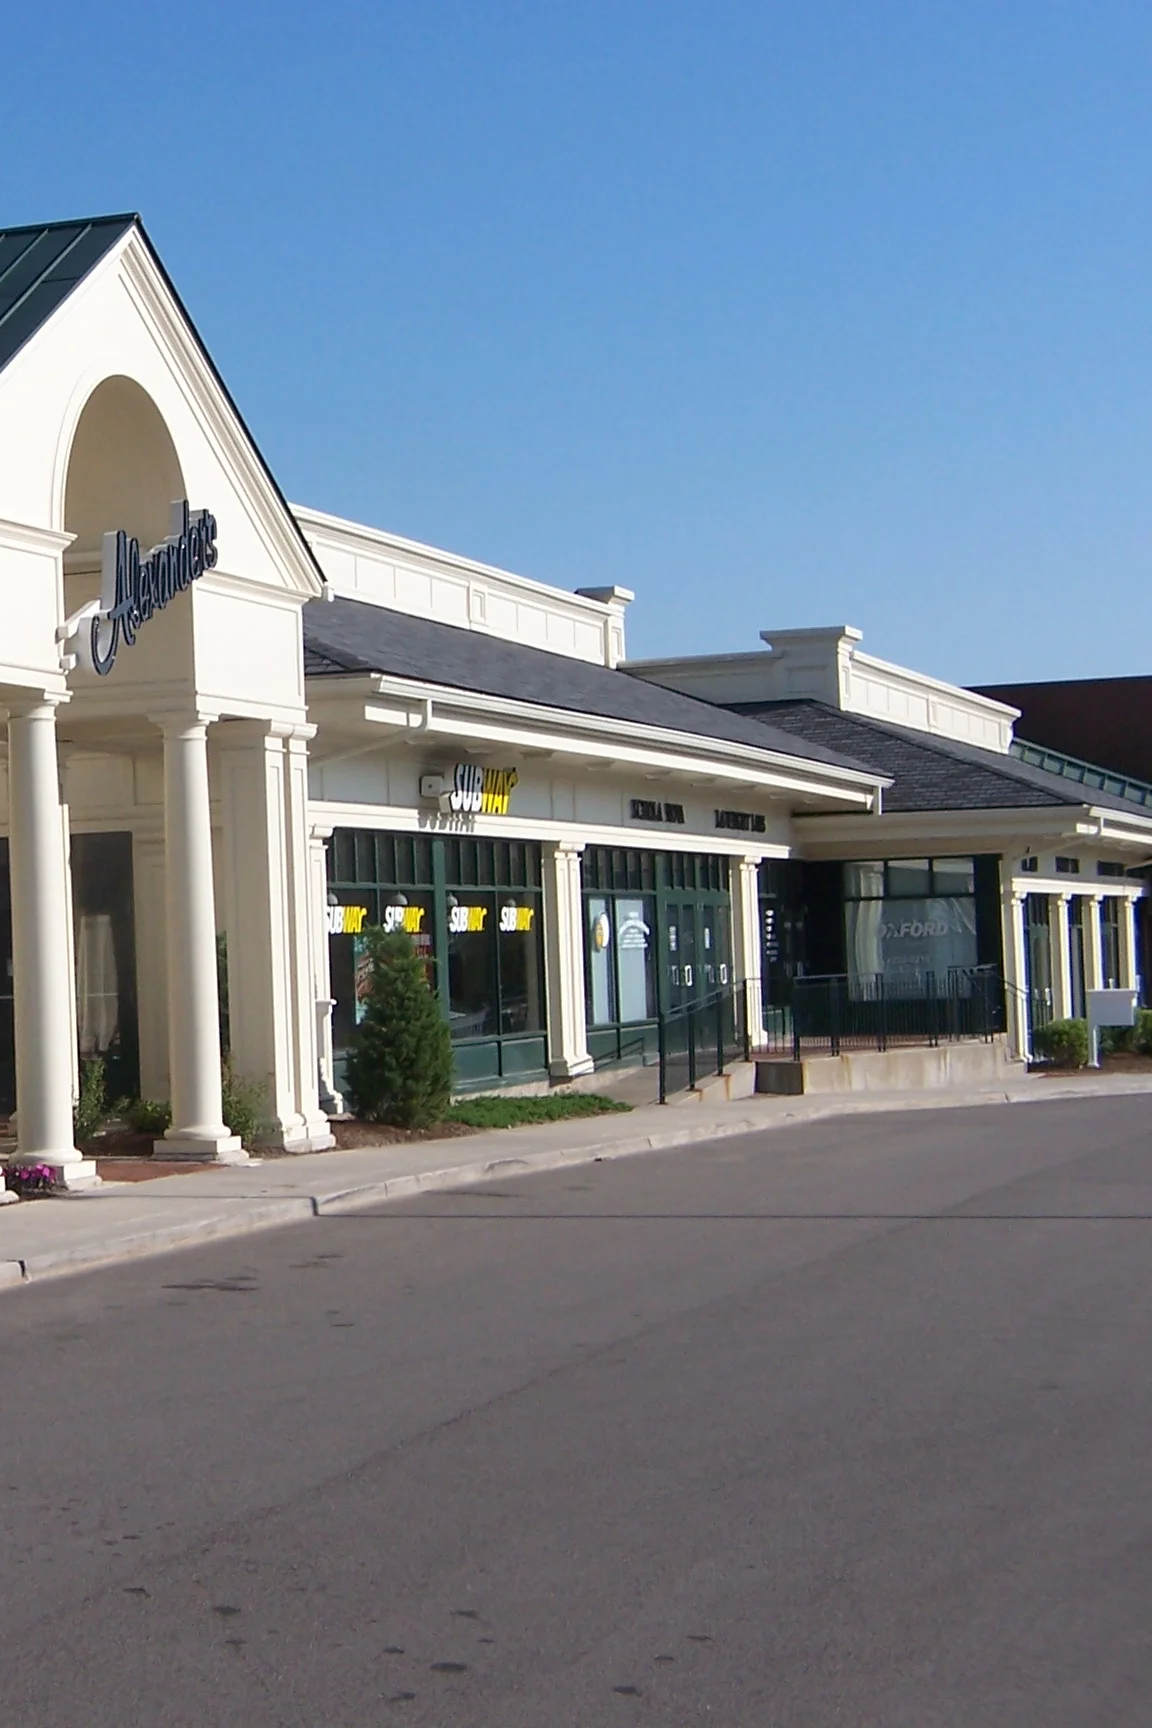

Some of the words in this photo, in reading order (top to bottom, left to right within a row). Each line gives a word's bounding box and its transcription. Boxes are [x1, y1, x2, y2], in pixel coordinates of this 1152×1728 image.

[449, 763, 519, 815] SUBWAY
[449, 905, 488, 933] SUBWAY
[499, 906, 534, 932] SUBWAY
